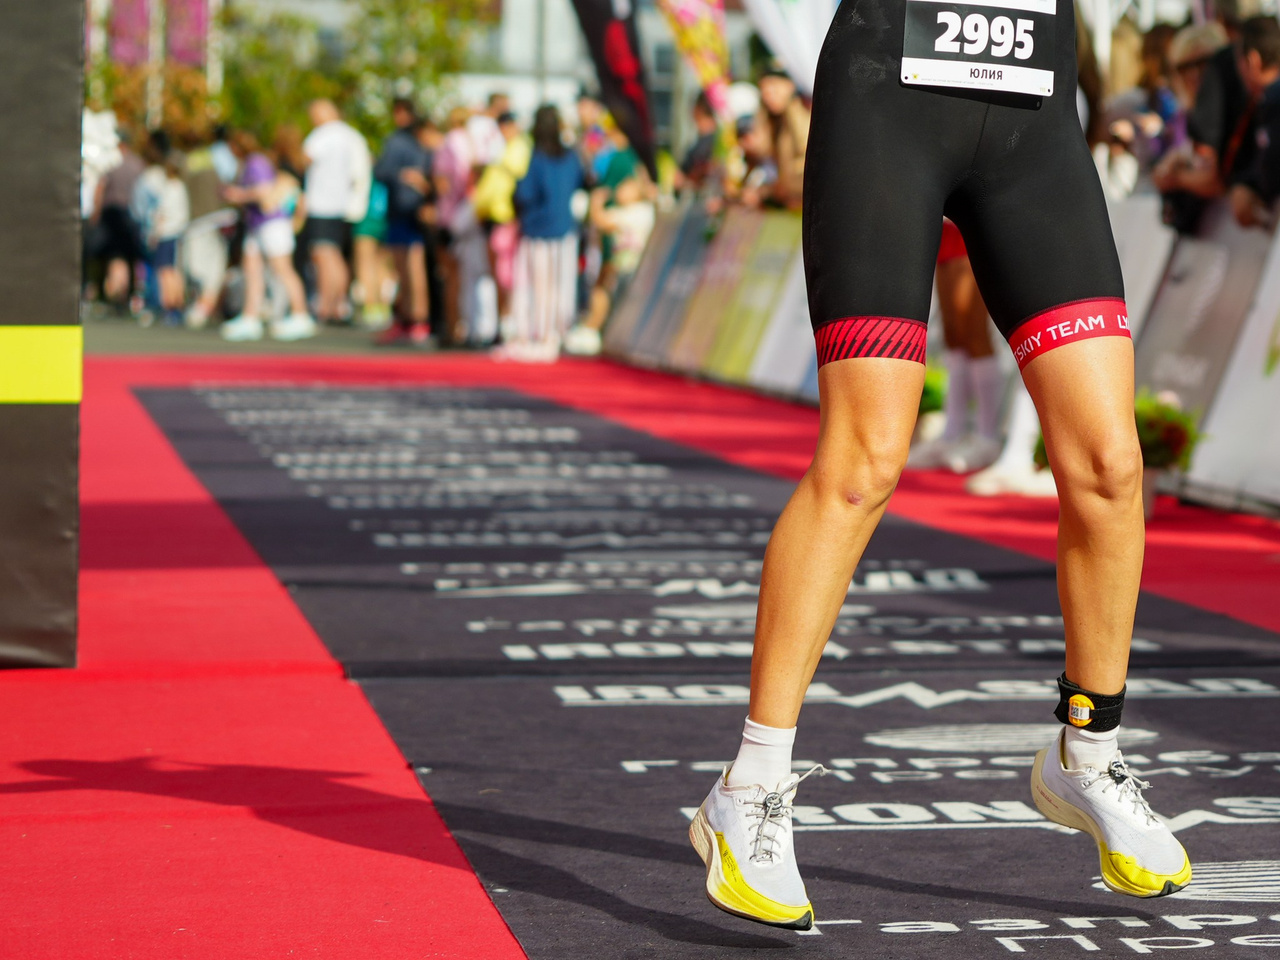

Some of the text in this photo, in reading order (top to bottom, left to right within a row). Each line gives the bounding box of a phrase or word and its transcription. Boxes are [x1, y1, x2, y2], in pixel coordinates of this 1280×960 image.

[934, 11, 1034, 60] 2995
[969, 68, 1003, 81] ЮЛИЯ
[1046, 314, 1105, 341] TEAM
[1117, 314, 1131, 331] LY
[977, 678, 1270, 695] SAR
